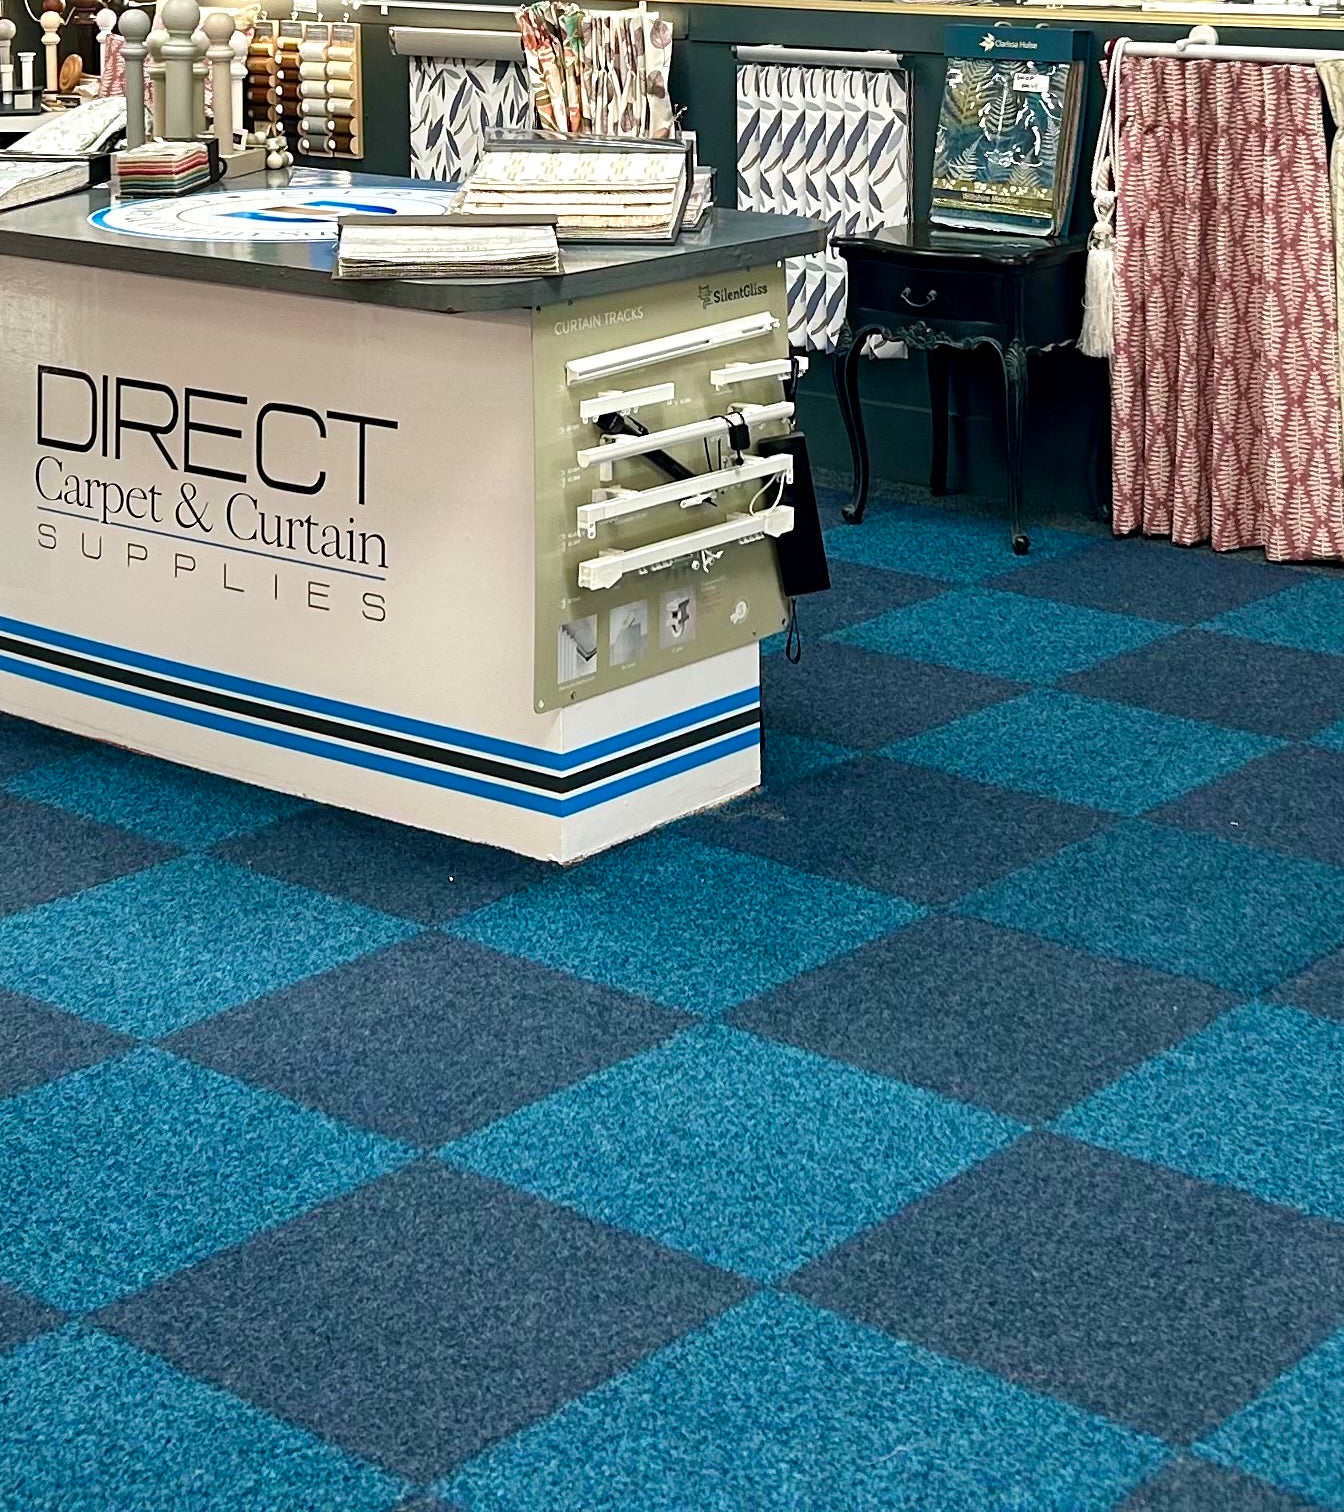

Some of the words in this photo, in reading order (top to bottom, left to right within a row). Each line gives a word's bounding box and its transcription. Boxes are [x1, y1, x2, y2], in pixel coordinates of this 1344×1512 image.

[554, 314, 602, 336] CURTAIN
[604, 305, 645, 326] TRACKS
[36, 363, 399, 506] DIRECT
[34, 455, 164, 525] Carpet
[174, 481, 214, 534] &
[225, 492, 389, 569] Curtain
[37, 521, 387, 624] SUPPLIES
